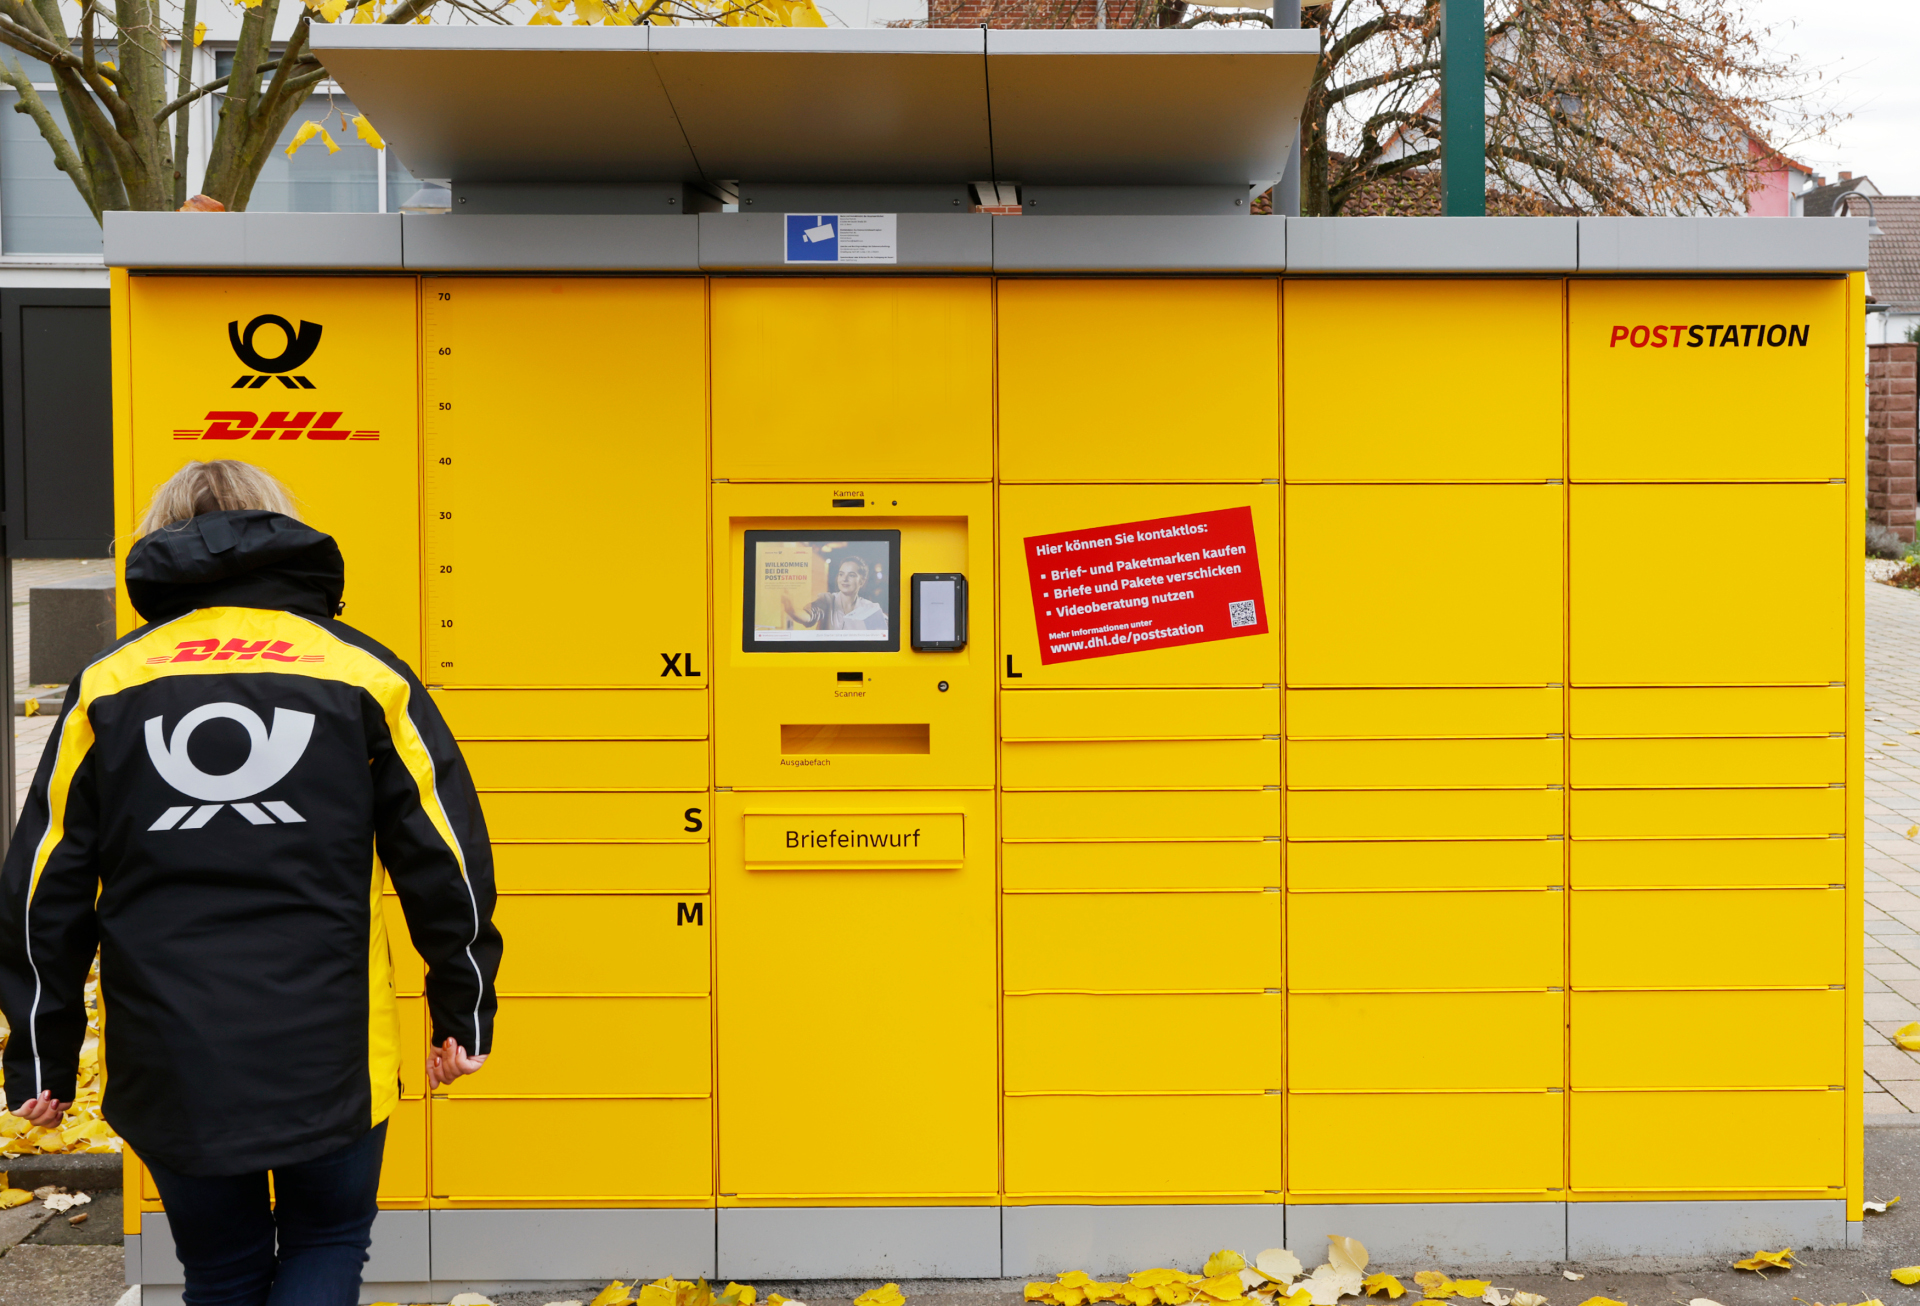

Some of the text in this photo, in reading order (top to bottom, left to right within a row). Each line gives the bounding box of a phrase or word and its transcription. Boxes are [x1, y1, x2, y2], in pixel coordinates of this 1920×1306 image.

[438, 293, 451, 301] 70
[1610, 324, 1809, 348] POSTSTATION
[438, 402, 451, 410] 50
[202, 411, 351, 440] DHL
[1036, 524, 1208, 556] Hier können Sie kontaktlos:
[1051, 545, 1246, 580] Brief- und Paketmarken kaufen
[1054, 565, 1242, 599] Briefe und Pakete verschicken
[1056, 590, 1194, 618] Videoberatung nutzen
[1049, 620, 1152, 640] Mehr Informationen unter
[1050, 624, 1204, 654] www.dhl.de/poststation
[170, 638, 304, 663] DHL
[660, 653, 701, 677] XL
[1006, 655, 1022, 678] L
[834, 690, 866, 698] Scanner
[780, 758, 830, 768] Ausgabefach
[684, 808, 703, 832] S
[785, 828, 921, 848] Briefeinwurf
[676, 902, 704, 926] M
